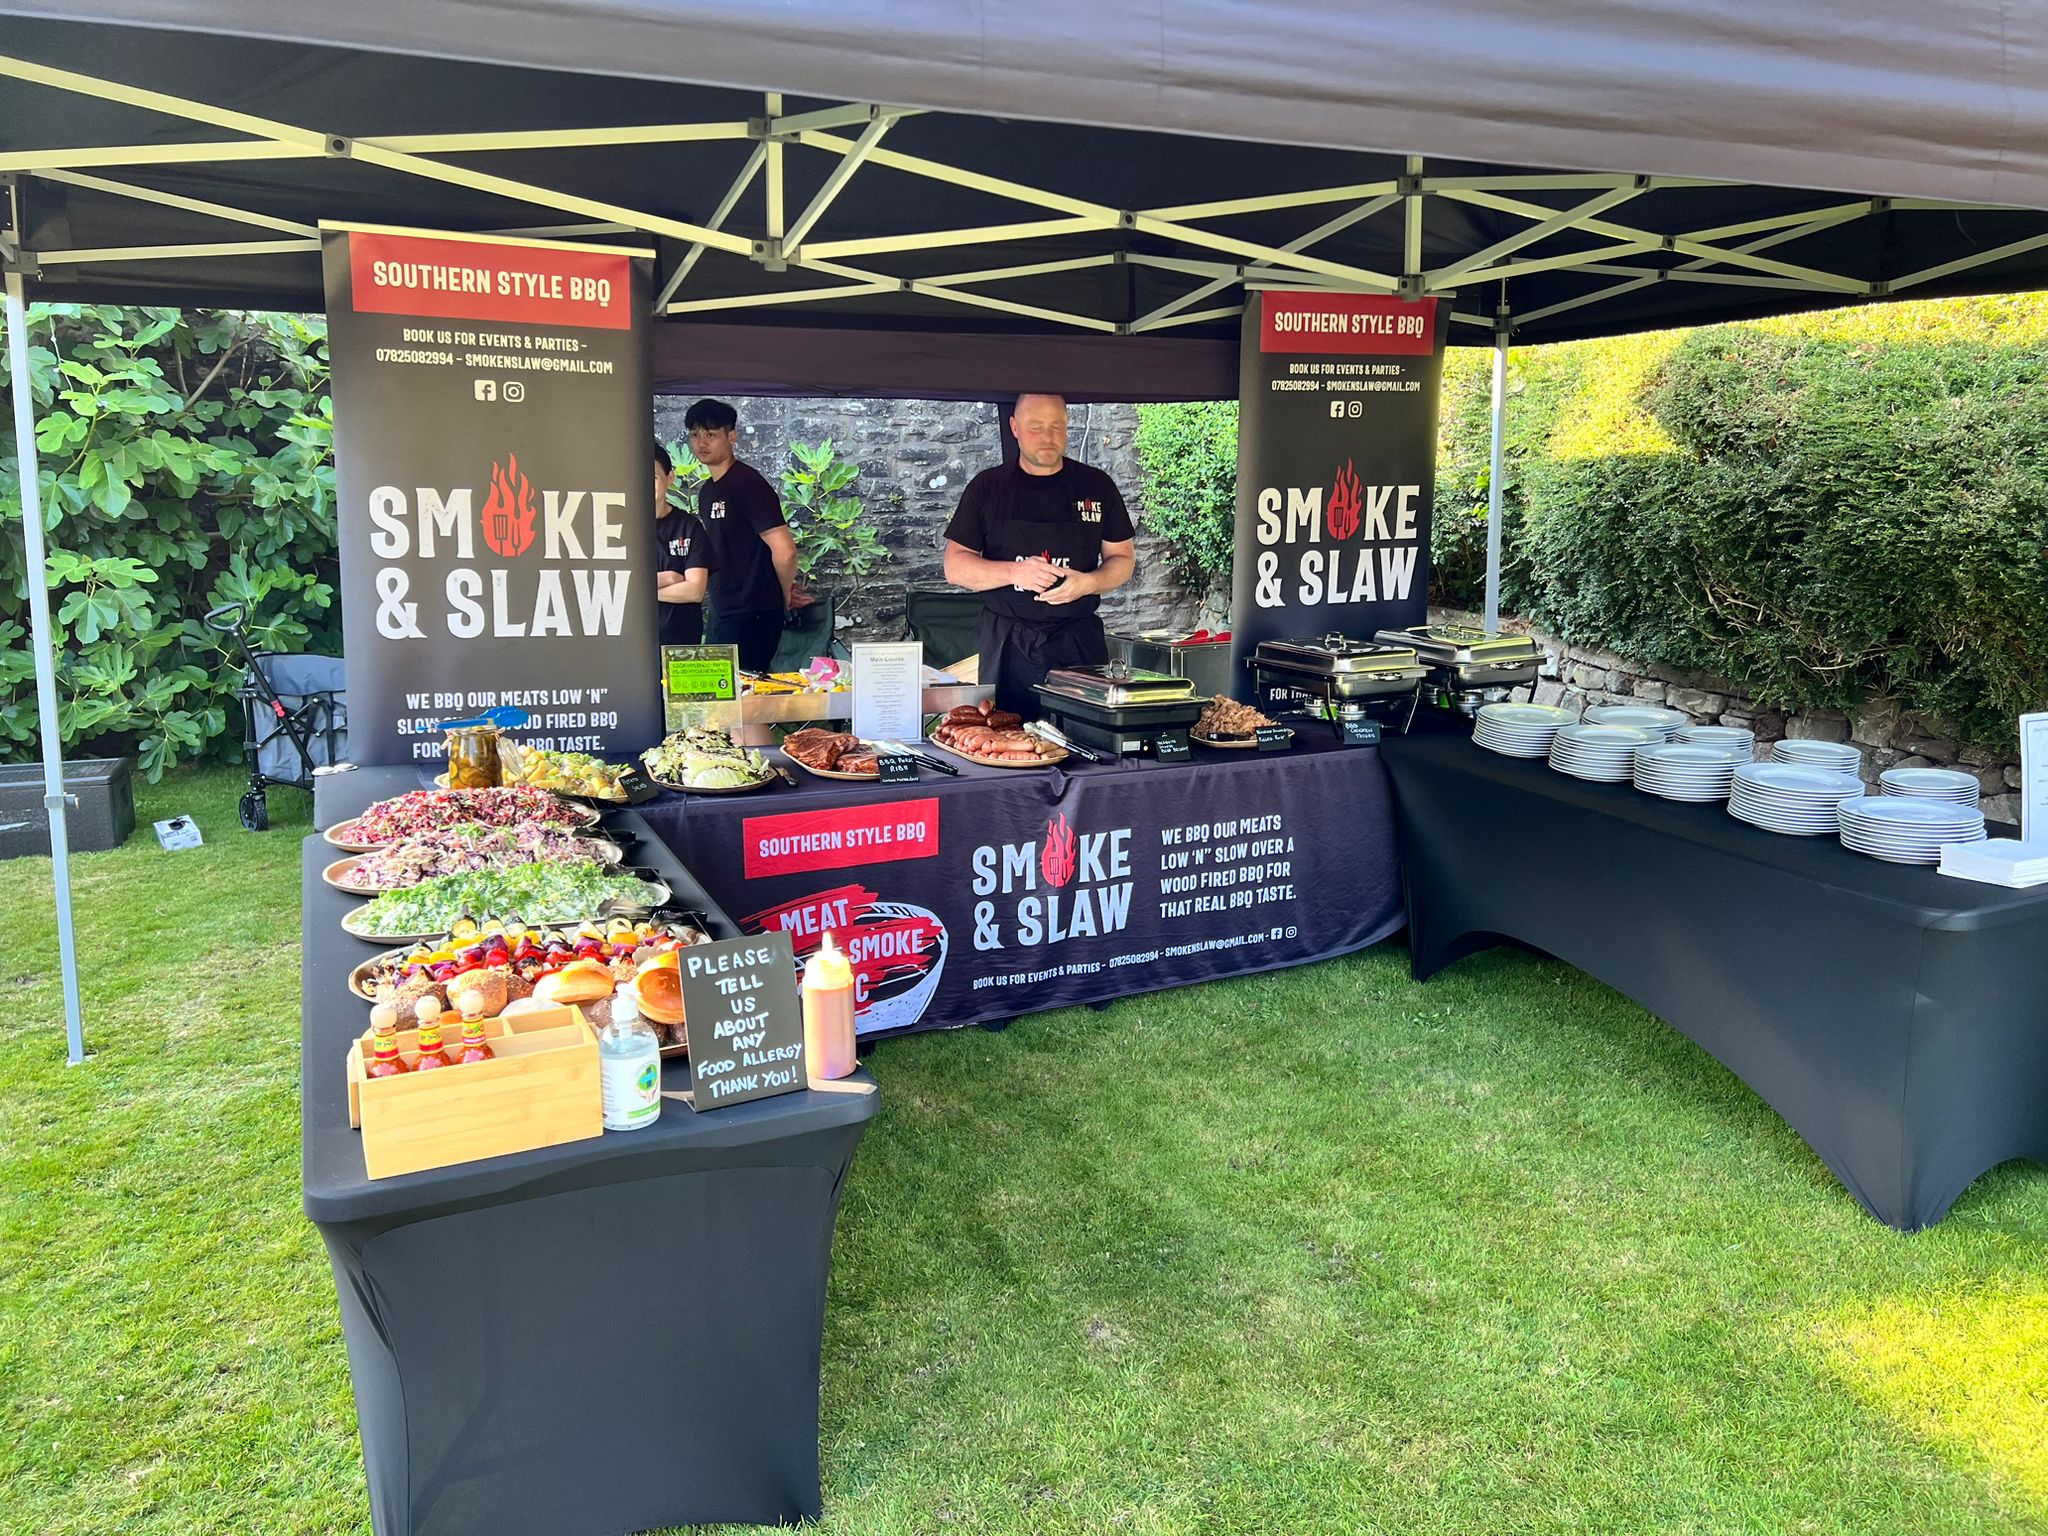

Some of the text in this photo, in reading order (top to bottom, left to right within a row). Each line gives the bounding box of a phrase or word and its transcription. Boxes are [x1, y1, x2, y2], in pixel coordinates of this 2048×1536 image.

[373, 260, 611, 307] SOUTHERN STYLE BBQ
[1274, 312, 1424, 338] SOUTHERN STYLE BBQ
[403, 328, 435, 343] BOOK
[437, 331, 452, 344] US
[454, 331, 476, 346] FOR
[479, 333, 521, 349] EVENTS
[524, 336, 532, 349] &
[535, 337, 579, 352] PARTIES
[376, 348, 453, 366] 07825082994
[465, 353, 613, 374] SMOKENSLAW@GMAIL.COM
[1289, 363, 1309, 374] BOOK
[1310, 364, 1320, 375] US
[1321, 364, 1335, 375] FOR
[1336, 364, 1363, 375] EVENTS
[1365, 365, 1370, 375] &
[1372, 365, 1400, 375] PARTIES
[1272, 380, 1320, 391] 07825082994
[1326, 380, 1420, 392] SMOKENSLAW@GMAIL.COM
[1081, 511, 1102, 522] SLAW
[1255, 547, 1419, 608] & SLAW
[375, 567, 632, 640] & SLAW
[720, 680, 727, 688] 5
[1270, 687, 1288, 701] FOR
[405, 693, 429, 710] WE
[434, 692, 463, 711] BBQ
[467, 692, 497, 708] OUR
[501, 690, 549, 706] MEATS
[552, 689, 582, 705] LOW
[546, 713, 585, 729] FIRED
[590, 711, 618, 730] BBQ
[412, 742, 441, 759] FOR
[557, 735, 605, 752] TASTE.
[879, 758, 896, 766] BBQ
[759, 821, 926, 858] SOUTHERN STYLE BBQ
[1161, 815, 1282, 846] WE BBQ OUR MEATS
[1160, 852, 1188, 870] LOW
[1215, 843, 1248, 863] SLOW
[1251, 839, 1284, 858] OVER
[1287, 837, 1295, 853] A
[1160, 861, 1291, 895] WOOD FIRED BBQ FOR
[1159, 884, 1297, 919] THAT REAL BBQ TASTE.
[779, 898, 849, 937] MEAT
[972, 882, 1134, 951] & SLAW
[849, 928, 924, 965] SMOKE
[687, 947, 770, 978] PLEASE
[973, 975, 994, 990] BOOK
[996, 973, 1008, 986] US
[1009, 972, 1026, 985] FOR
[1028, 967, 1058, 983] EVENTS
[1058, 965, 1065, 976] &
[1066, 961, 1100, 976] PARTIES
[1109, 949, 1159, 969] 07825082994
[1165, 932, 1264, 958] SMOKENSLAW@GMAIL.COM
[715, 974, 764, 995] TELL
[730, 996, 756, 1014] US
[713, 1012, 770, 1040] ABOUT
[732, 1030, 766, 1052] ANY
[697, 1043, 802, 1080] FOOD ALLERGY
[709, 1074, 758, 1099] THANK
